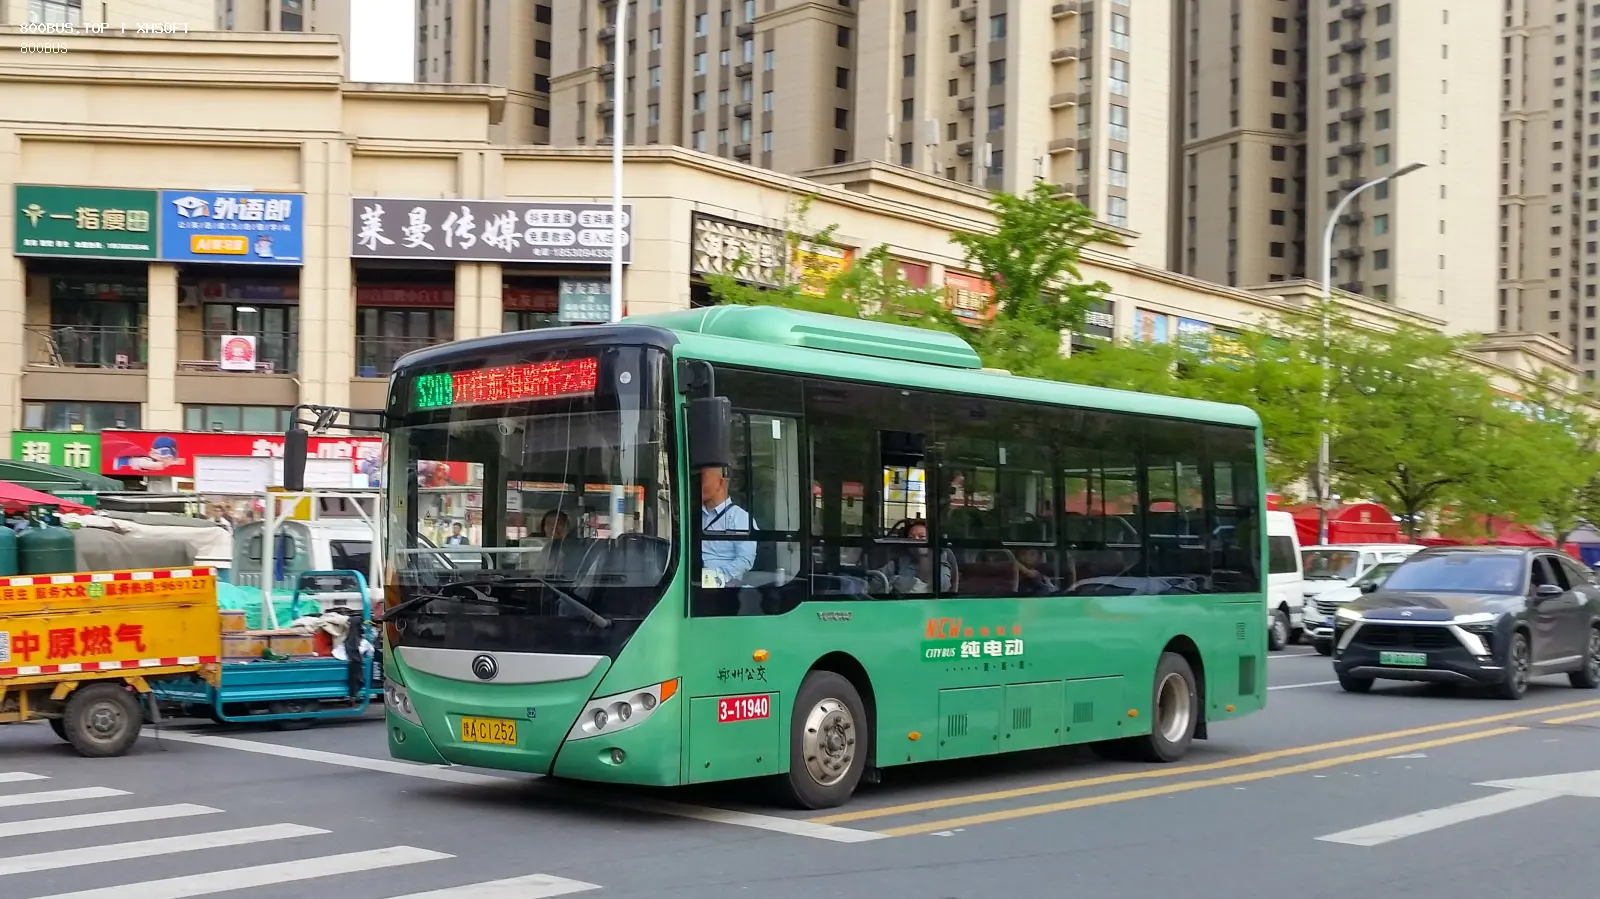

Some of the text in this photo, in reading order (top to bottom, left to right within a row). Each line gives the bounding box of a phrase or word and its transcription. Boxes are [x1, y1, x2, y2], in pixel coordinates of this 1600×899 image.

[357, 204, 524, 252] 莱曼传媒
[22, 440, 92, 469] 超市
[11, 623, 146, 662] 中原燃气
[961, 638, 1024, 658] 纯电动
[716, 665, 768, 684] 郑州公交
[720, 697, 768, 721] 3-11940
